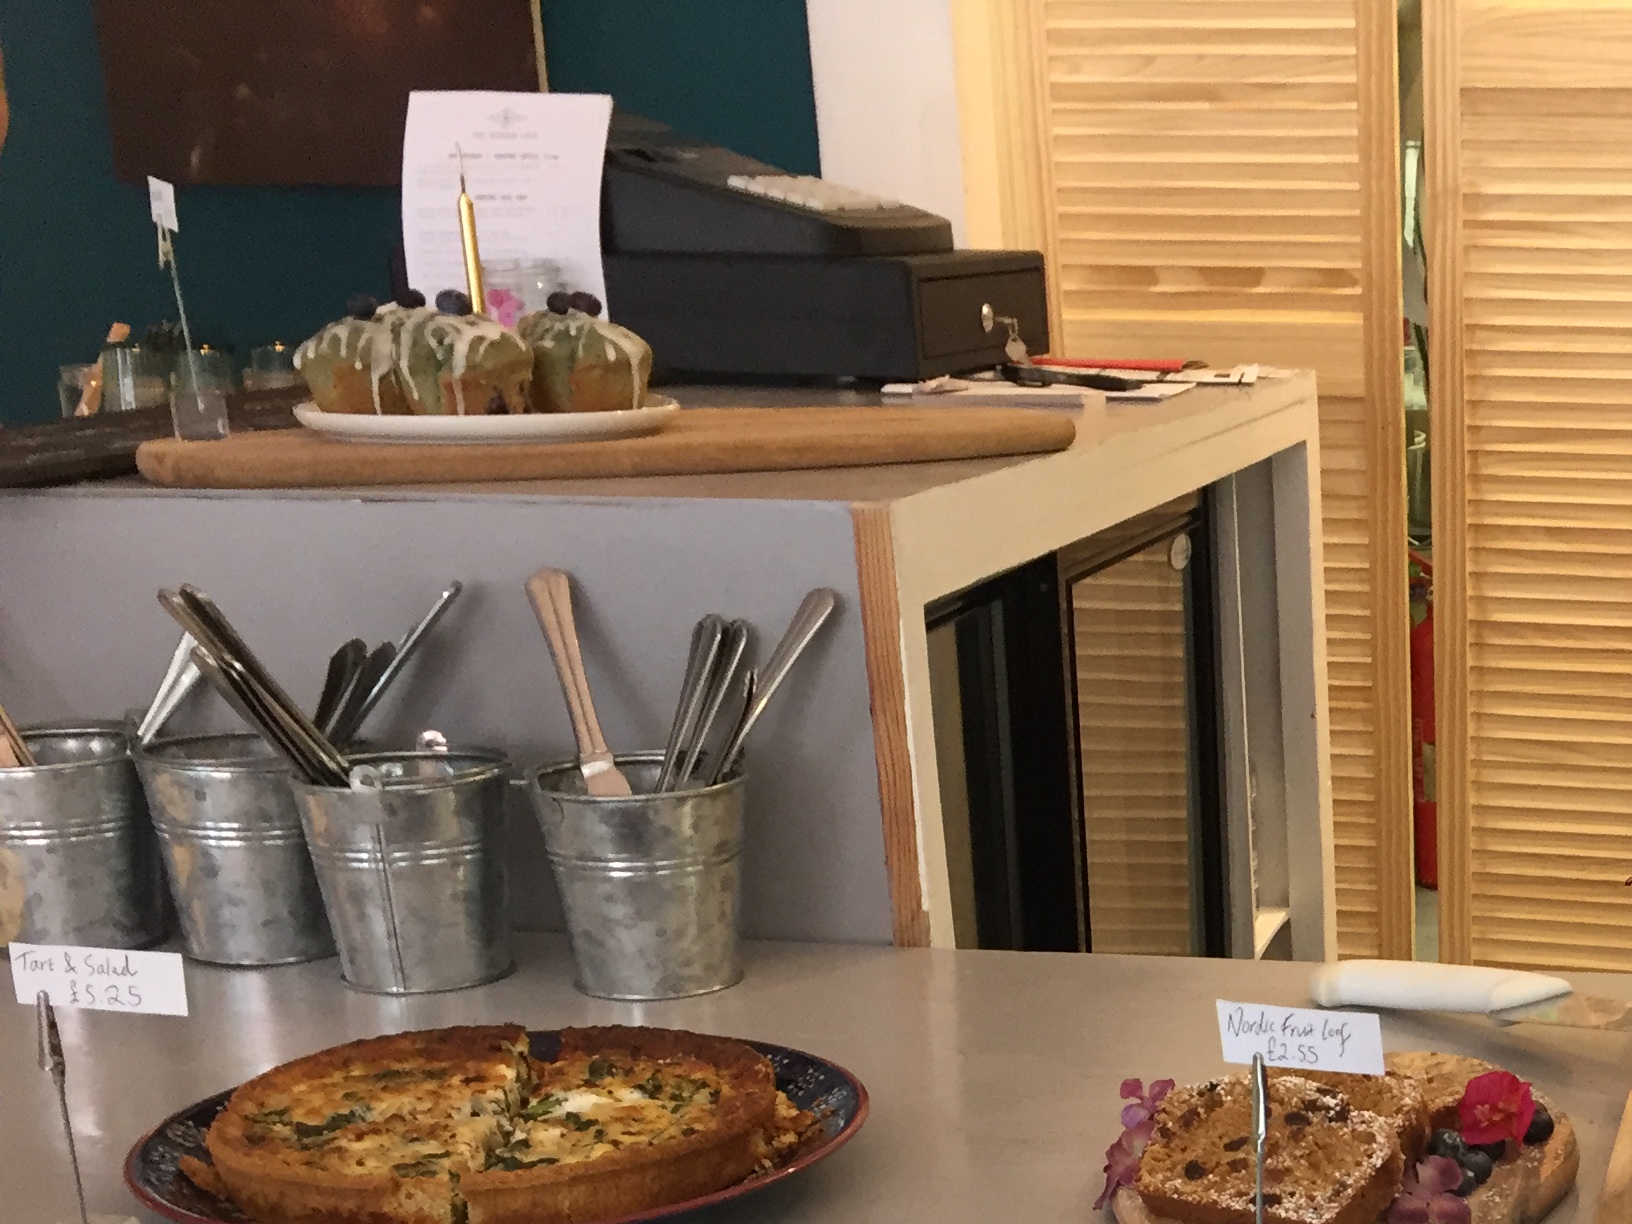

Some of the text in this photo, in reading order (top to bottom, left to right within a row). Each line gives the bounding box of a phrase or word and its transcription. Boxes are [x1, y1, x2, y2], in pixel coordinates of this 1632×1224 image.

[15, 951, 138, 977] Tart & Salad
[1227, 1007, 1275, 1037] Nordic
[1267, 1036, 1319, 1064] £2.55
